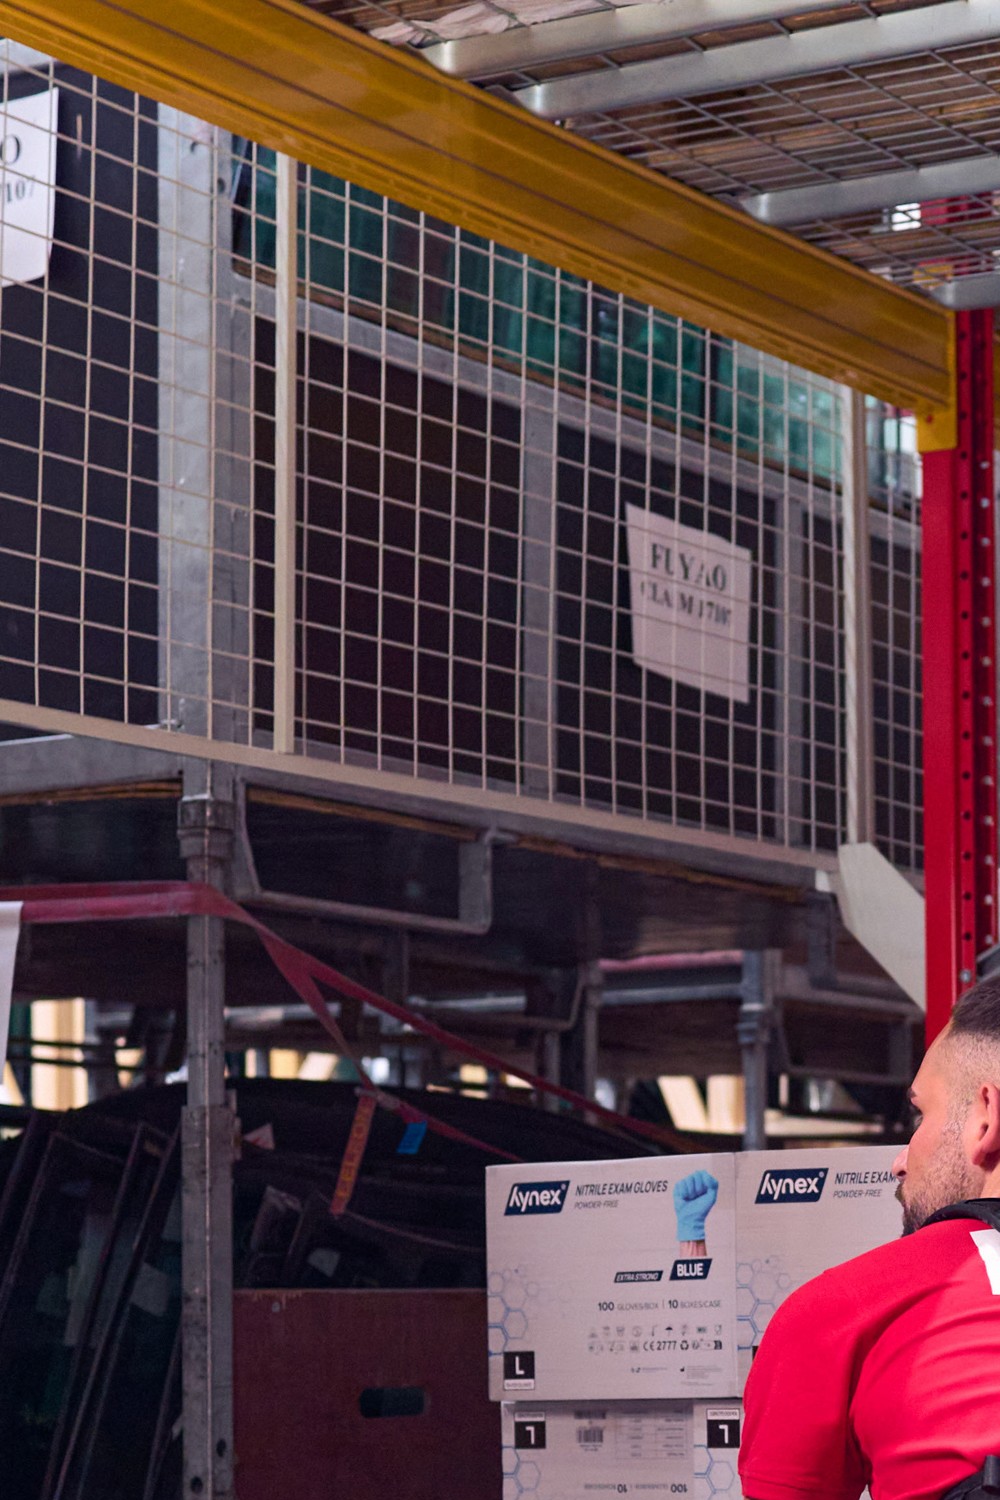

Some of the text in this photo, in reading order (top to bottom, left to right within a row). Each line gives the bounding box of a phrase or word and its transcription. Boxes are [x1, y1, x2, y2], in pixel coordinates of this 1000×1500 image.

[835, 1171, 896, 1184] NITRILE EXAM
[575, 1181, 668, 1197] NITRILE EXAM GLOVES
[833, 1189, 882, 1198] POWDER-FREE
[677, 1263, 704, 1277] BLUE
[598, 1302, 614, 1311] 100
[668, 1300, 678, 1309] 10
[657, 1341, 677, 1350] 2777
